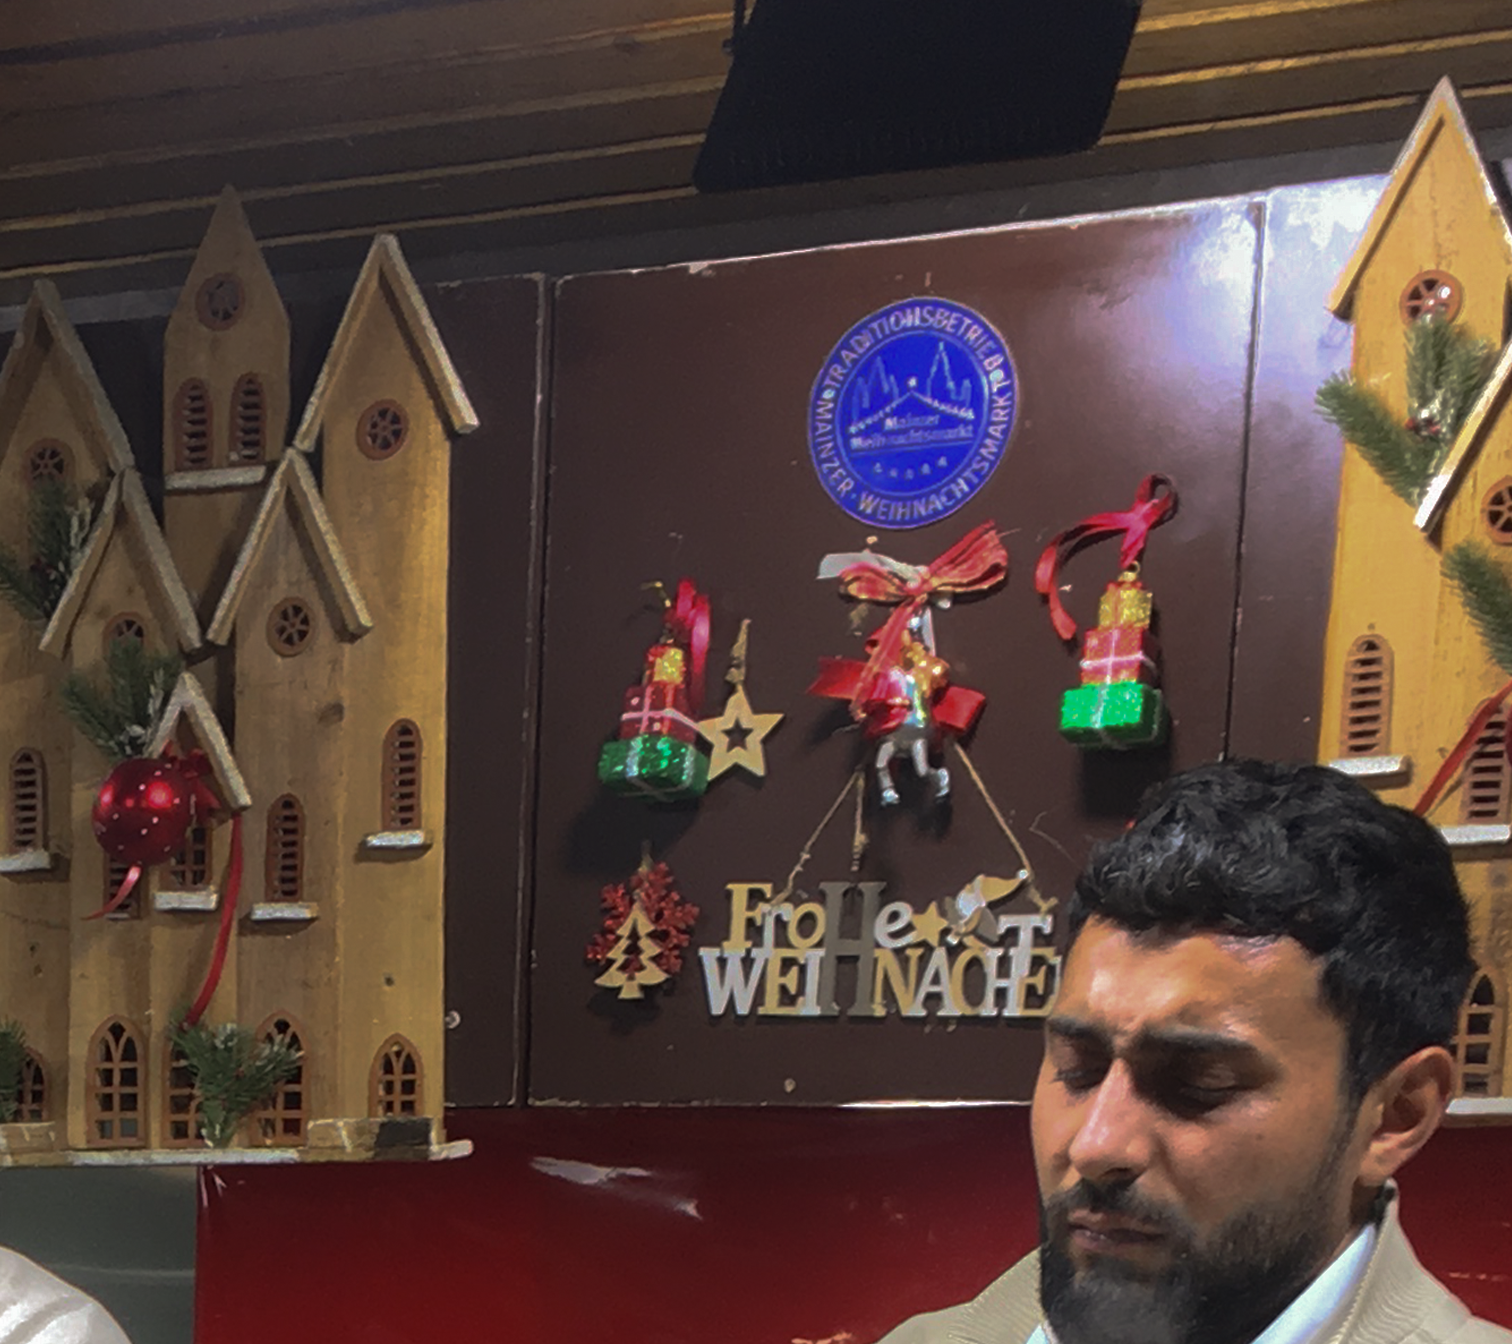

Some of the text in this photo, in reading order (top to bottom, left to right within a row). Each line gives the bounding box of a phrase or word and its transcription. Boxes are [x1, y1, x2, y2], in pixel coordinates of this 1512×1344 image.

[824, 305, 1004, 388] TRADITIONSBETRIEB
[815, 379, 1012, 521] MAINZER WEIHNACHTSMARKT
[699, 914, 1062, 1017] WEIHNACHTE
